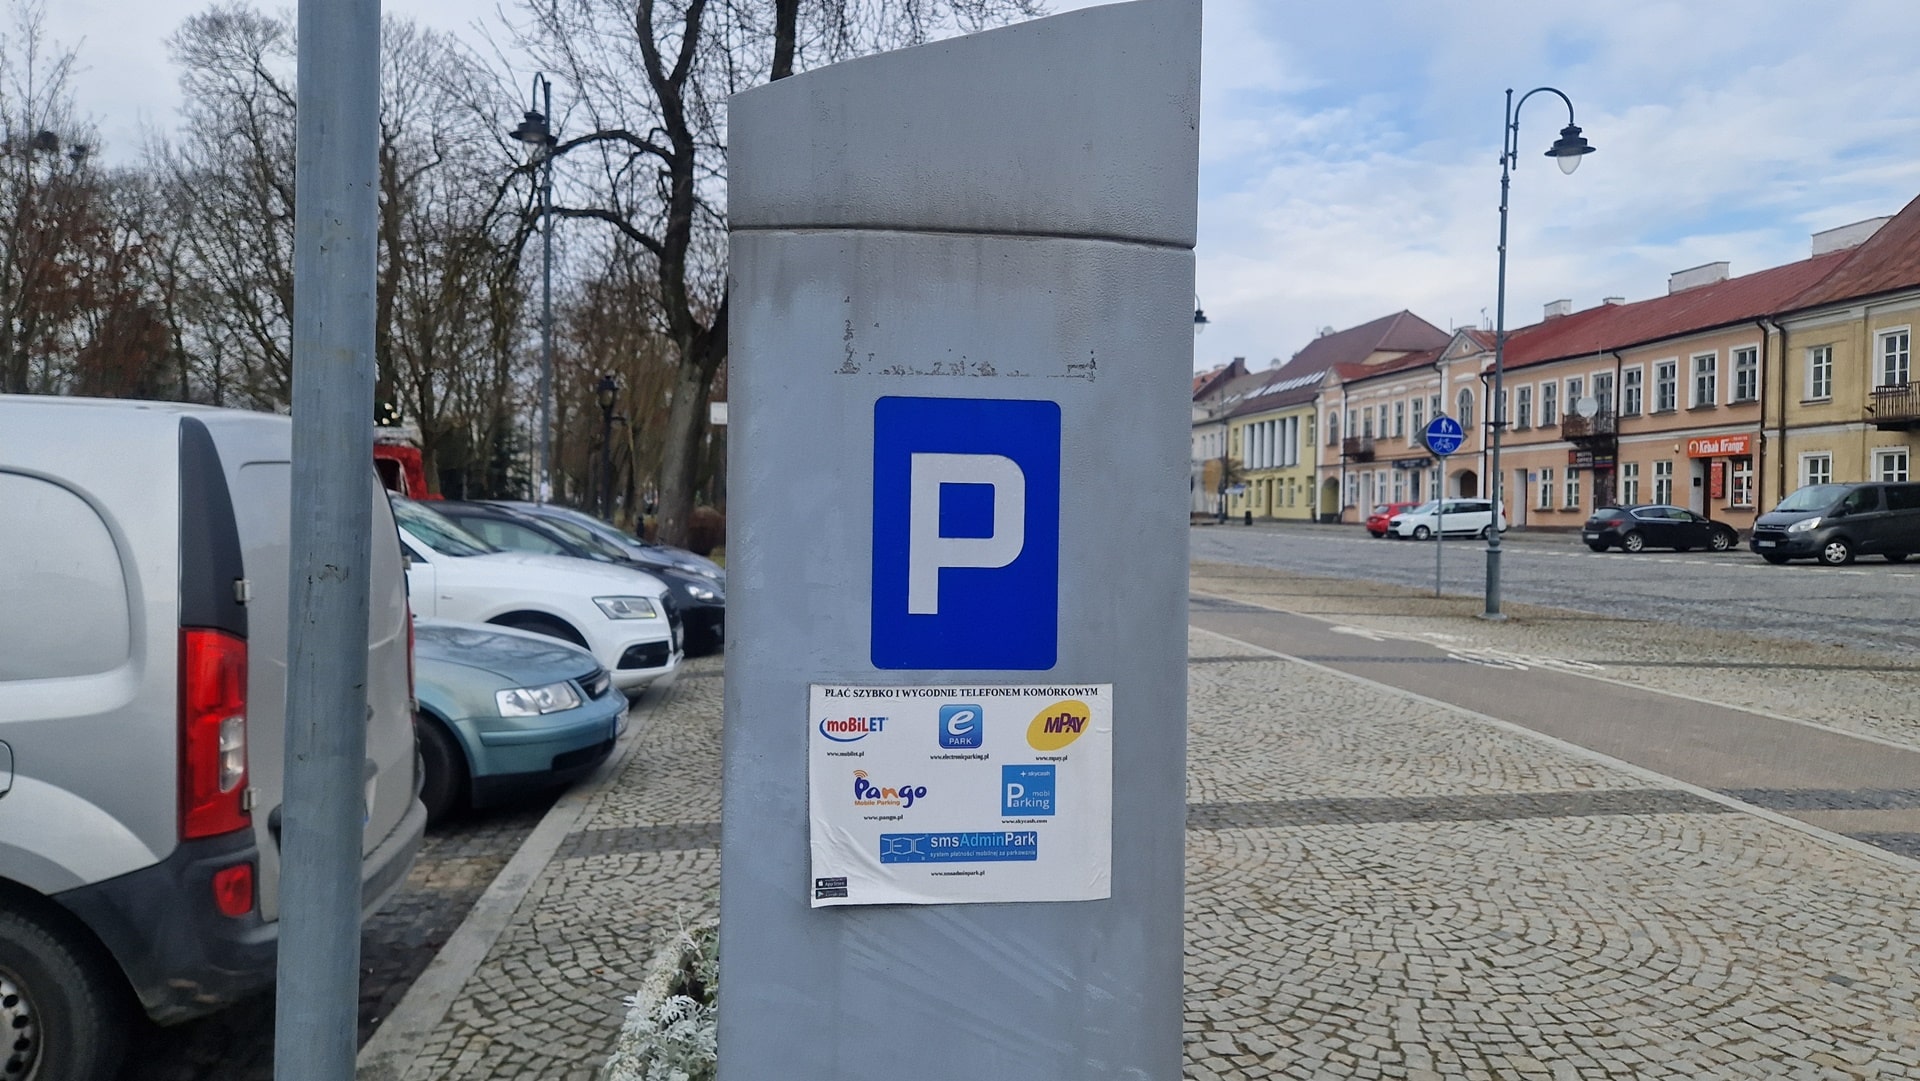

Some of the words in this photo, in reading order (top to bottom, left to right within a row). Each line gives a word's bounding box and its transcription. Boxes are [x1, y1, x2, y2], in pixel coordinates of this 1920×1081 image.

[908, 453, 1025, 615] P
[825, 688, 851, 698] PŁAĆ
[853, 689, 893, 698] SZYBKO
[896, 689, 900, 698] I
[902, 689, 957, 698] WYGODNIE
[960, 688, 1021, 697] TELEFONEM
[1023, 687, 1098, 697] KOMÓRKOWYM
[854, 777, 927, 808] Pango
[930, 832, 1036, 848] smsAdminPark
